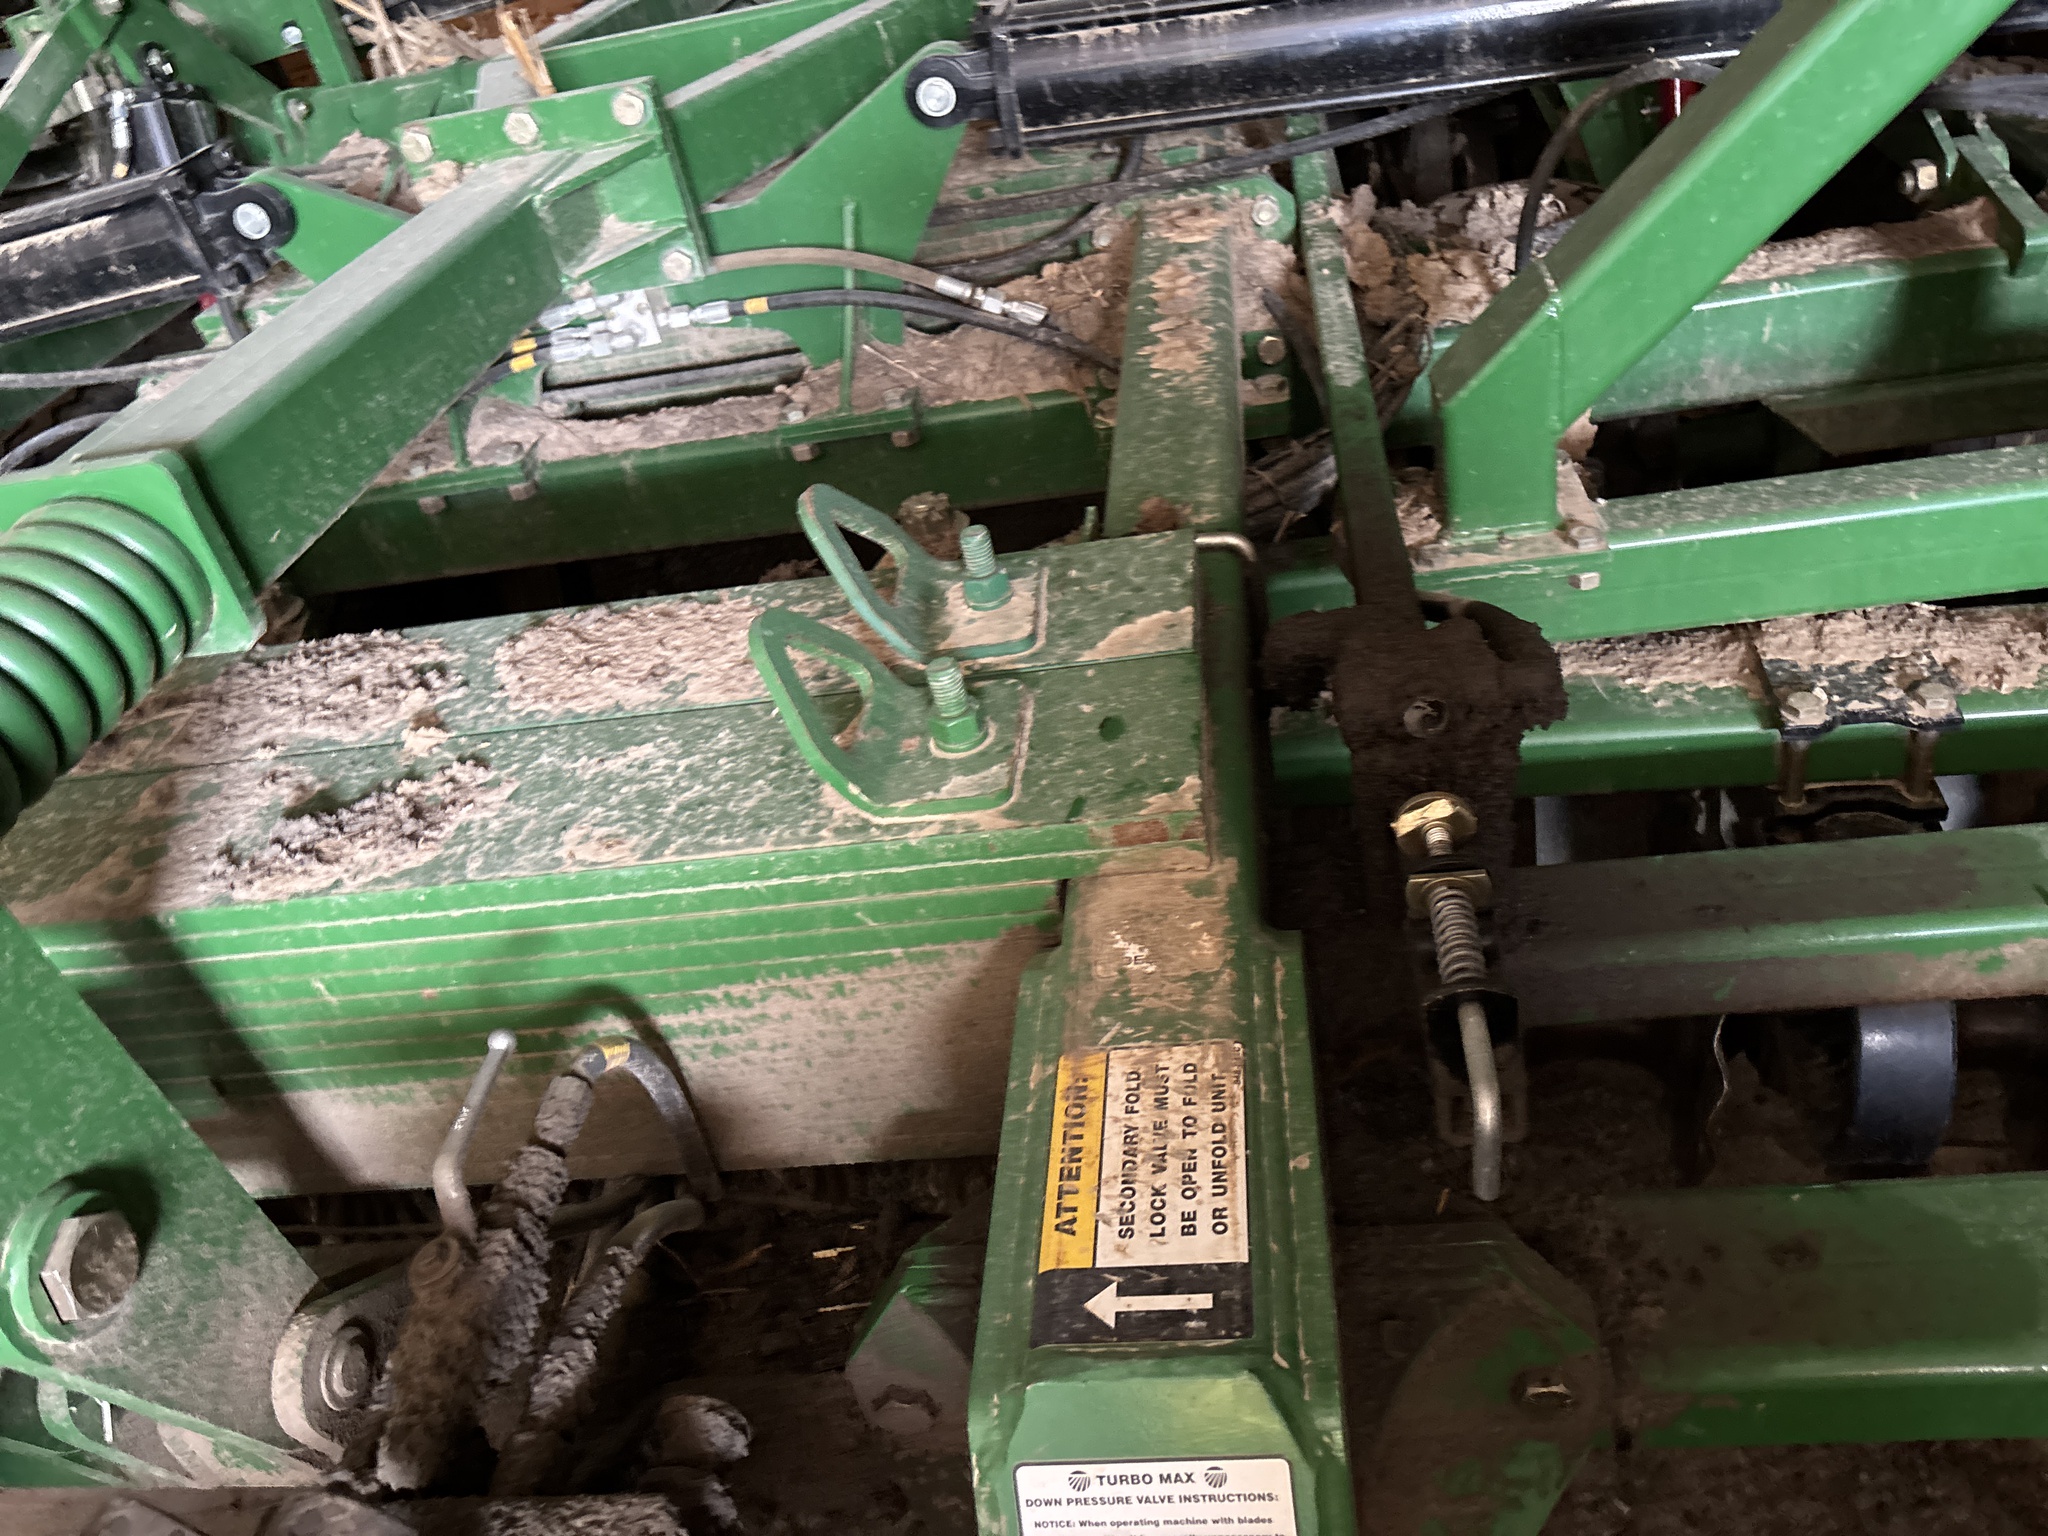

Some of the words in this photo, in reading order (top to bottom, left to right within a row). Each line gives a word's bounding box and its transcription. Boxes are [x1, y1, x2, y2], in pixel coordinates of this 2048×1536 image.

[1125, 1070, 1141, 1115] FOLD
[1211, 1072, 1227, 1113] UNIT
[1182, 1115, 1198, 1139] TO
[1054, 1077, 1089, 1237] ATTENTION:
[1181, 1148, 1198, 1200] OPEN
[1211, 1121, 1229, 1197] UNFOLD
[1118, 1123, 1139, 1239] SECONDARY
[1149, 1183, 1167, 1238] LOCK
[1181, 1209, 1197, 1237] BE
[1211, 1206, 1229, 1236] OR
[1096, 1473, 1153, 1486] TURBO
[1159, 1472, 1196, 1485] MAX
[1025, 1498, 1062, 1508] DOWN
[1066, 1496, 1133, 1507] PRESSURE
[1136, 1494, 1175, 1505] VALVE
[1178, 1492, 1279, 1503] INSTRUCTIONS:
[1034, 1519, 1076, 1529] NOTICE:
[1078, 1518, 1107, 1528] When
[1110, 1517, 1160, 1529] operating
[1163, 1516, 1209, 1526] machine
[1211, 1515, 1235, 1525] with
[1237, 1515, 1273, 1525] blades
